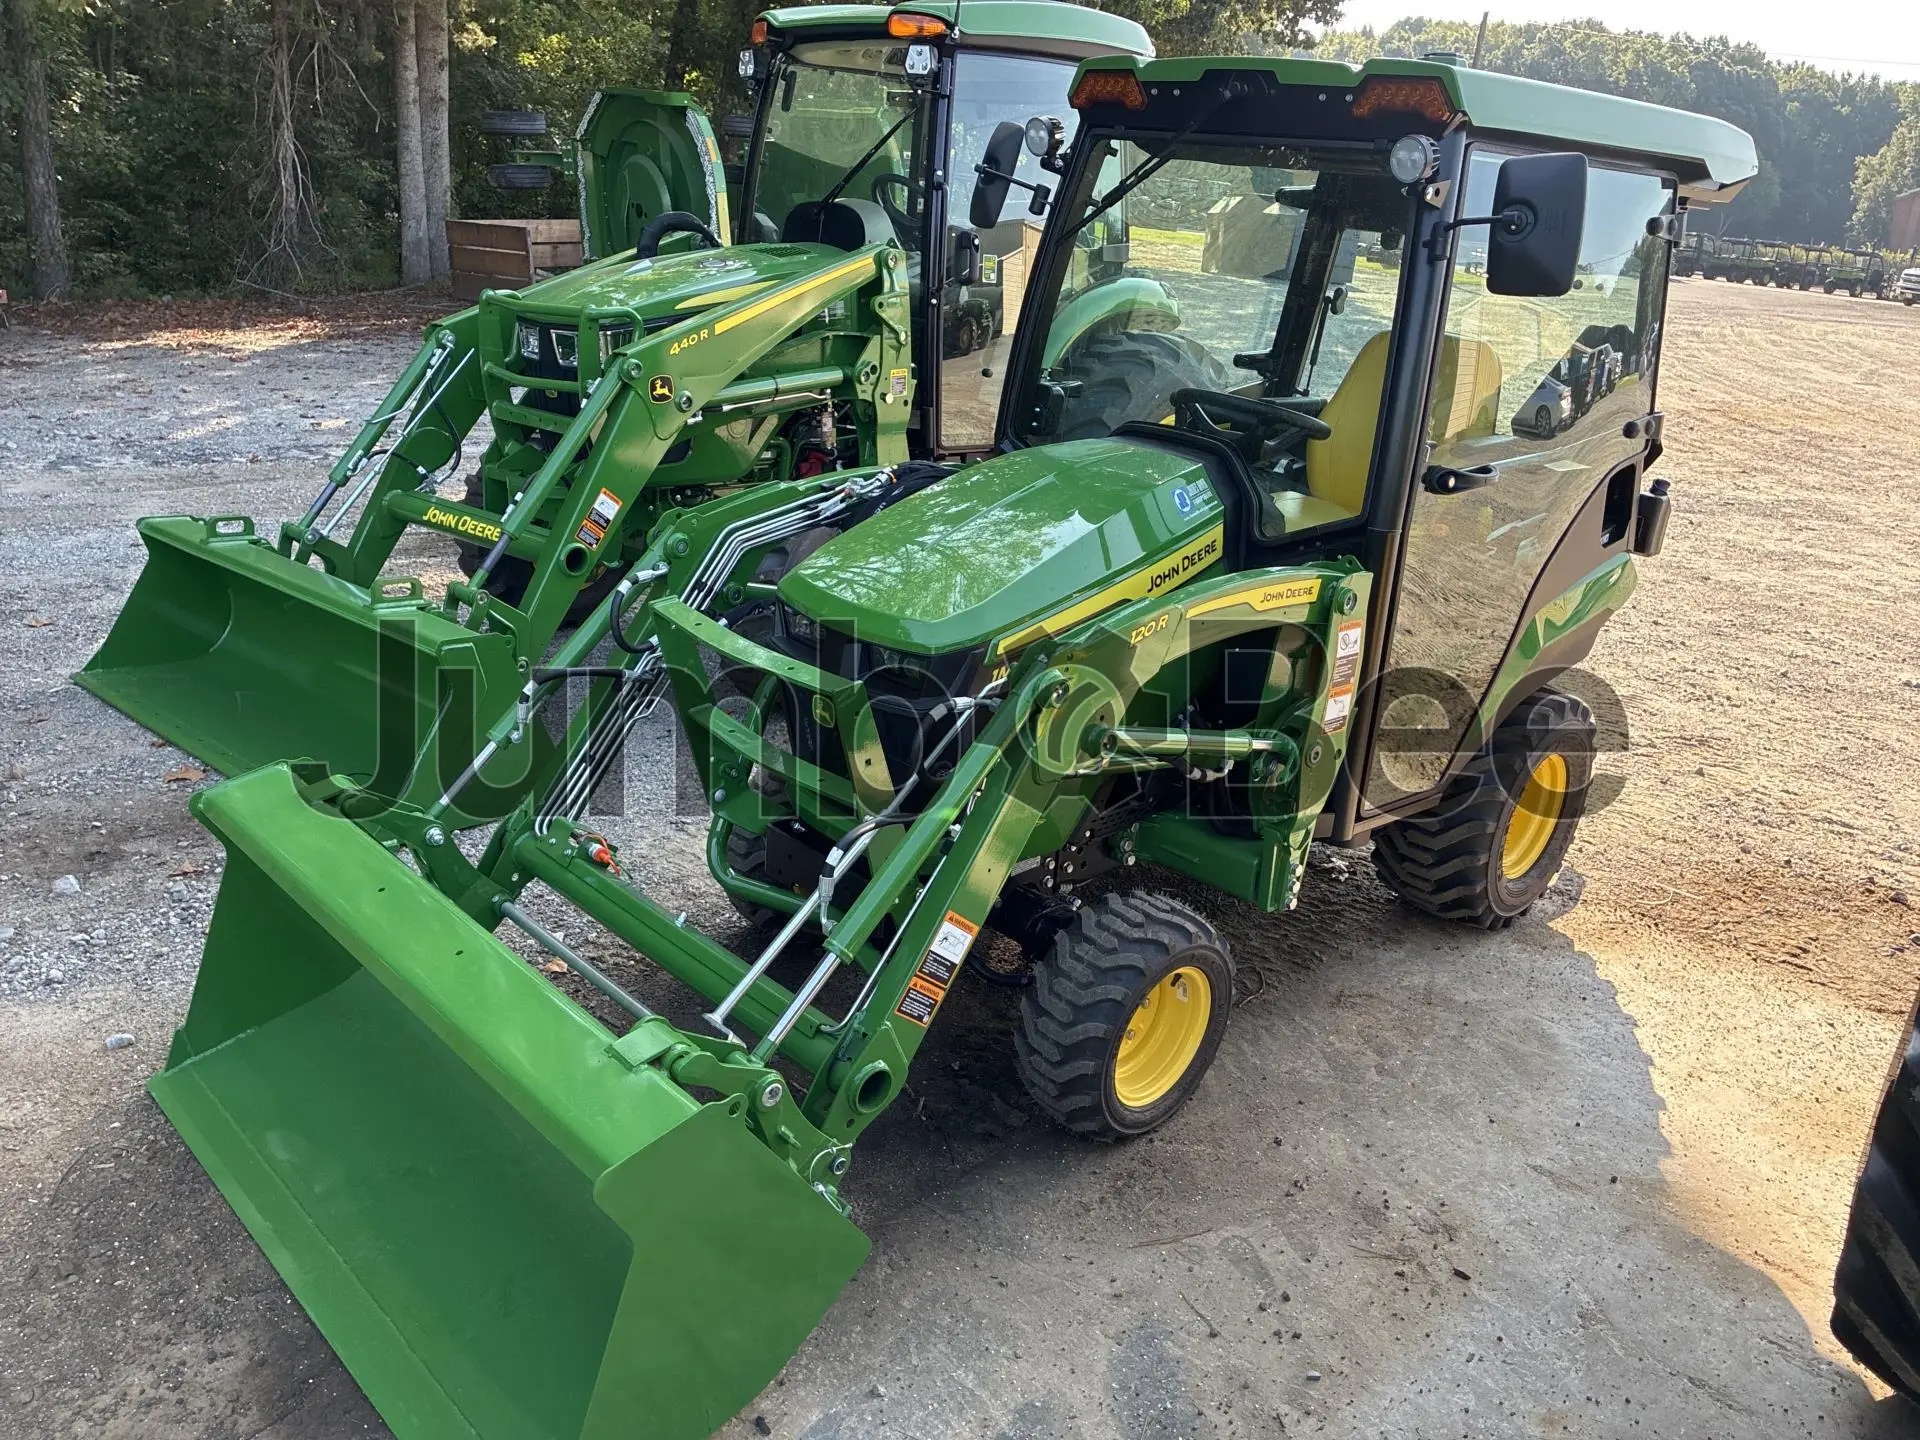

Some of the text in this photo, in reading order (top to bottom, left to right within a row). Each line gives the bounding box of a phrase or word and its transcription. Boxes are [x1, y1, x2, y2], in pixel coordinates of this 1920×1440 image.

[422, 506, 502, 542] JOHN DEERE
[1147, 539, 1218, 594] JOHN DEERE
[1259, 586, 1315, 604] JOHN DEERE
